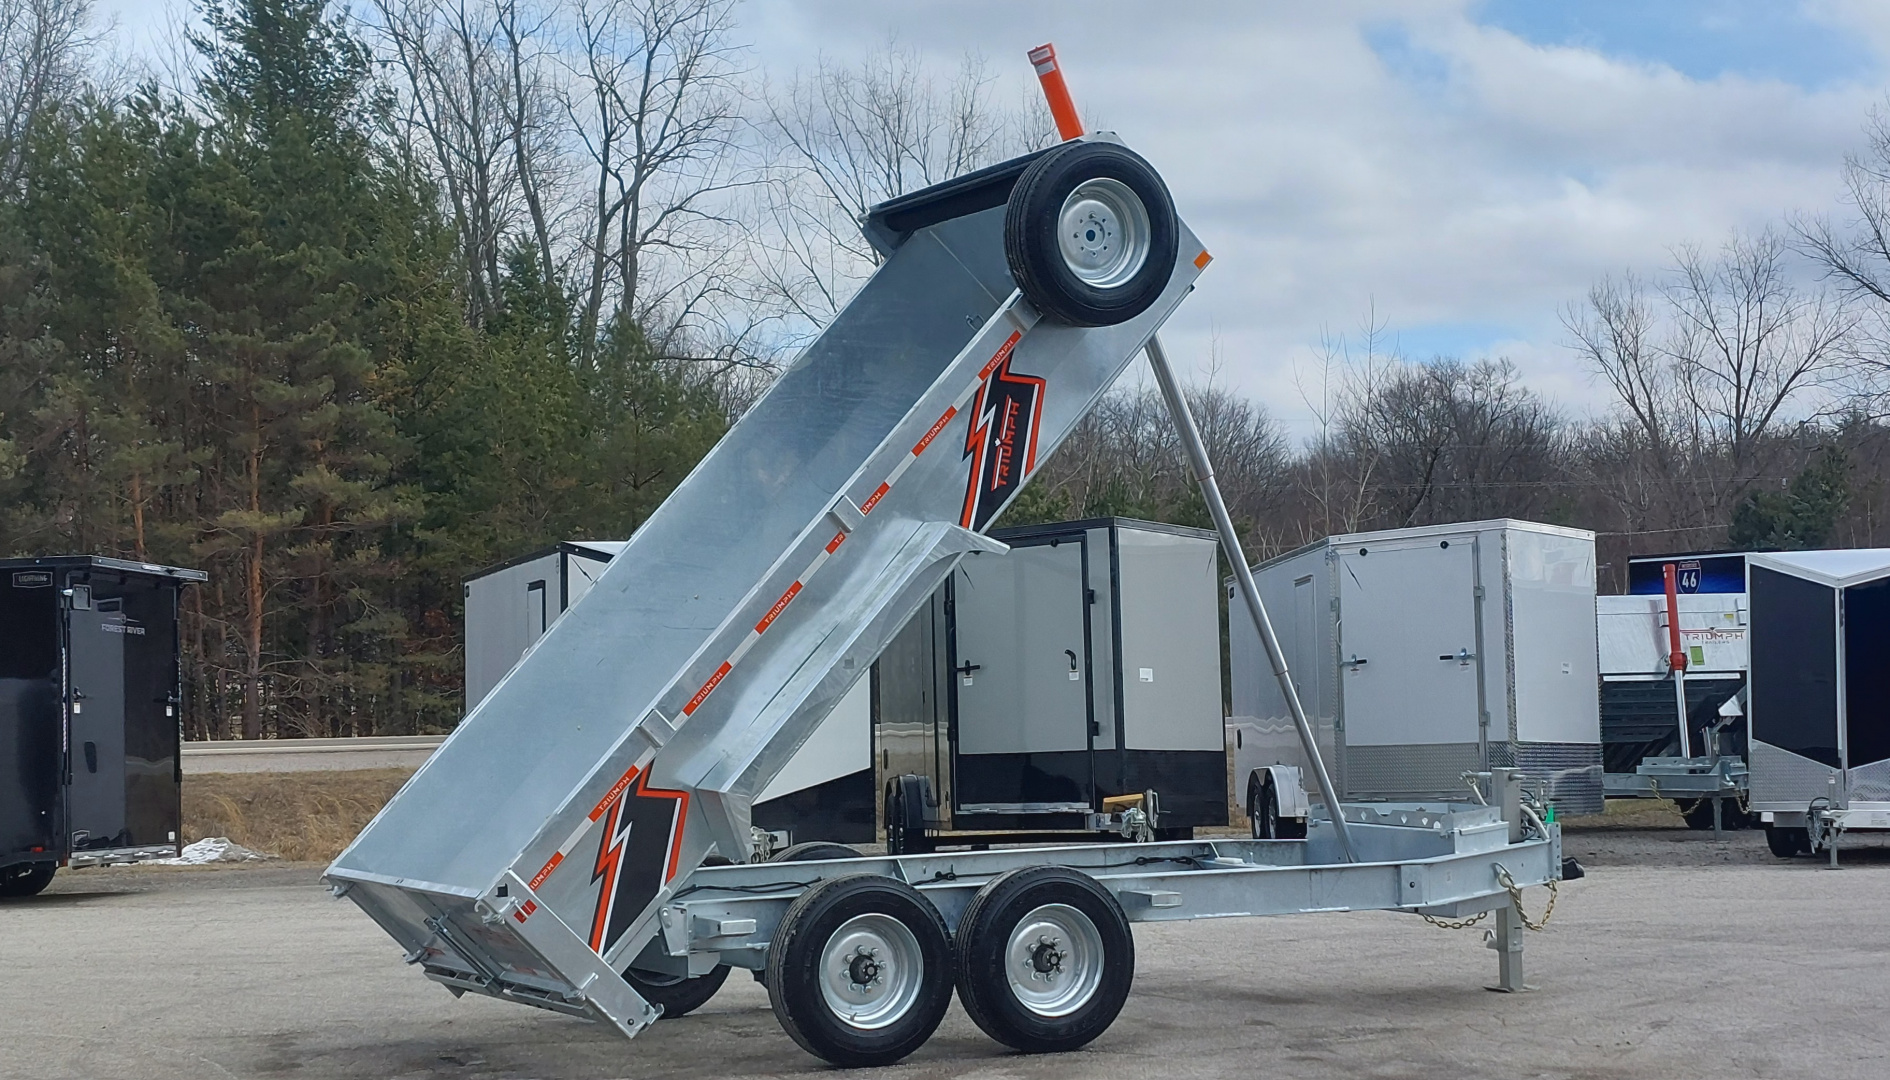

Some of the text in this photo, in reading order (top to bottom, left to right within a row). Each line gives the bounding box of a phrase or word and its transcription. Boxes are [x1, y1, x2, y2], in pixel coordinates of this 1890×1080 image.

[987, 340, 1013, 371] TRIUMPH
[921, 416, 949, 447] TRIUMPH
[998, 402, 1020, 486] TRIUMPH
[1682, 571, 1697, 588] 46
[765, 590, 795, 624] TRIUMPH
[101, 623, 146, 636] FOREST RIVER
[1685, 633, 1744, 641] TRIUMPH
[692, 672, 723, 705] TRIUMPH
[598, 776, 630, 811] TRIUMPH
